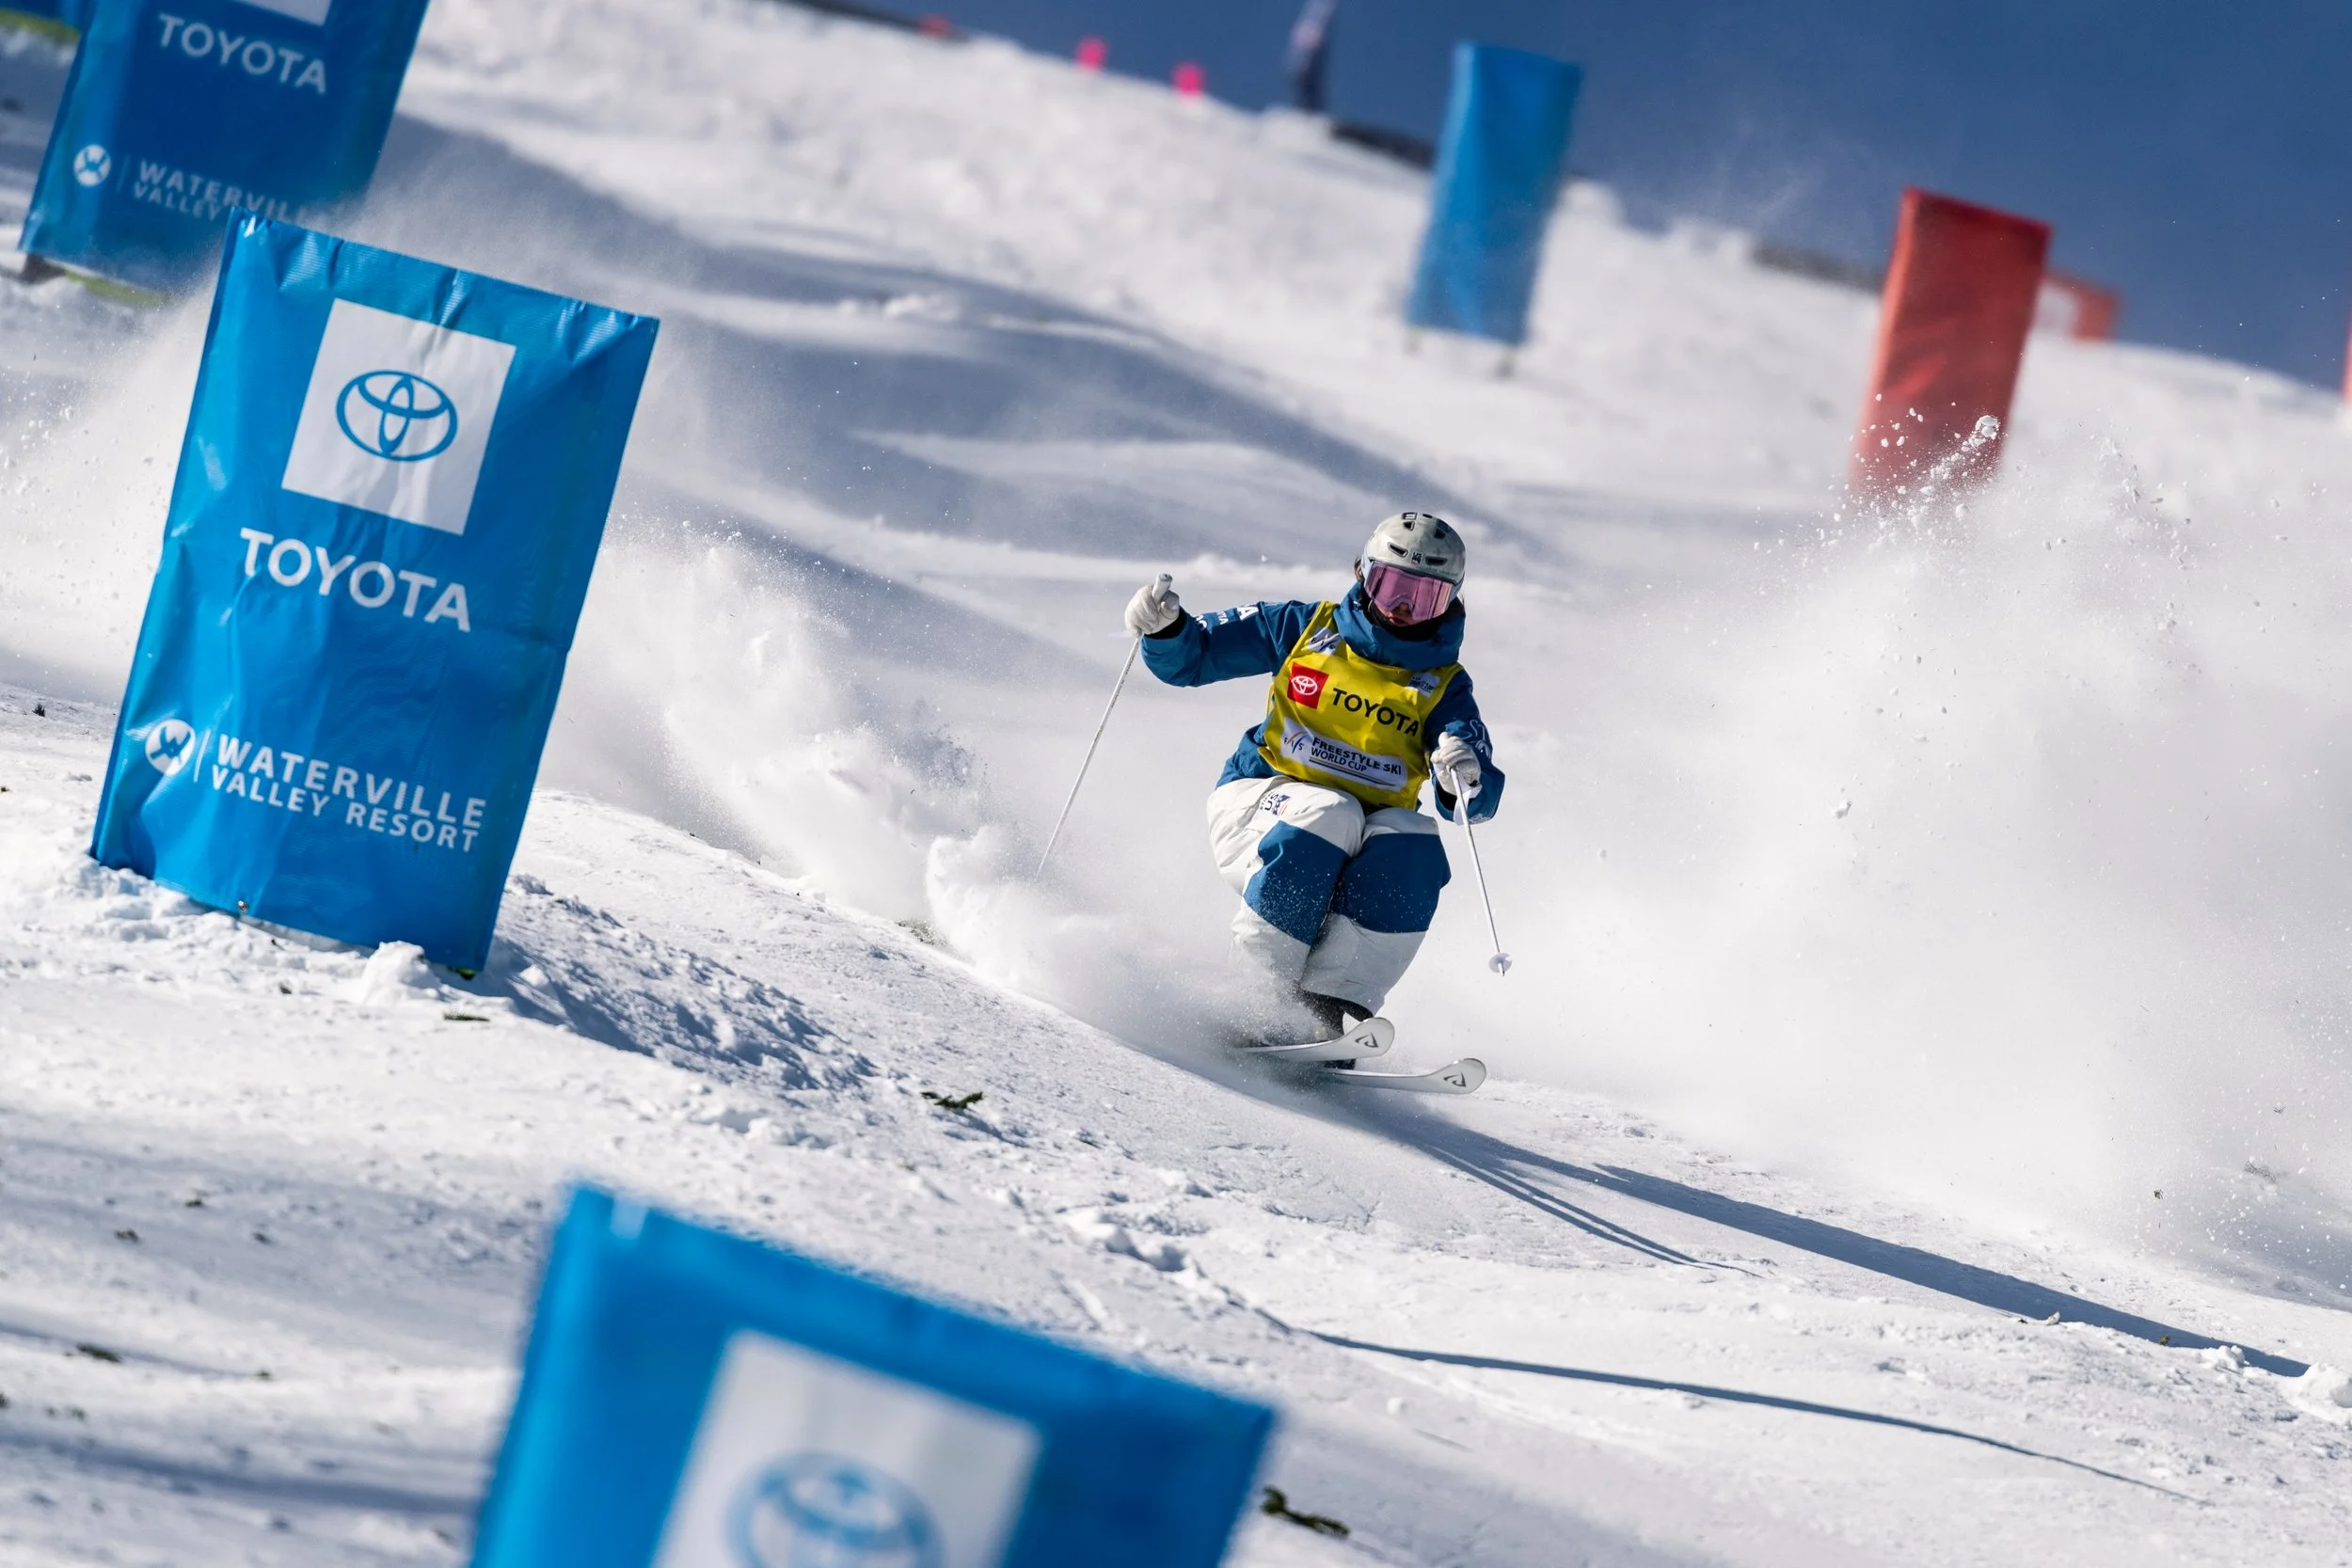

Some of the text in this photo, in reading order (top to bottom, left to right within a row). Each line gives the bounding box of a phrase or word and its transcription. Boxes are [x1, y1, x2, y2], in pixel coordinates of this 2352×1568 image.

[158, 12, 326, 94] TOYOTA
[134, 181, 221, 222] VALLEY
[239, 527, 470, 633] TOYOTA
[1332, 688, 1420, 736] TOYOTA
[217, 733, 486, 829] WATERVILLE
[1311, 736, 1402, 776] FREESTYLE SKI
[1311, 747, 1368, 772] WORLD CUP
[212, 764, 479, 852] VALLEY RESORT
